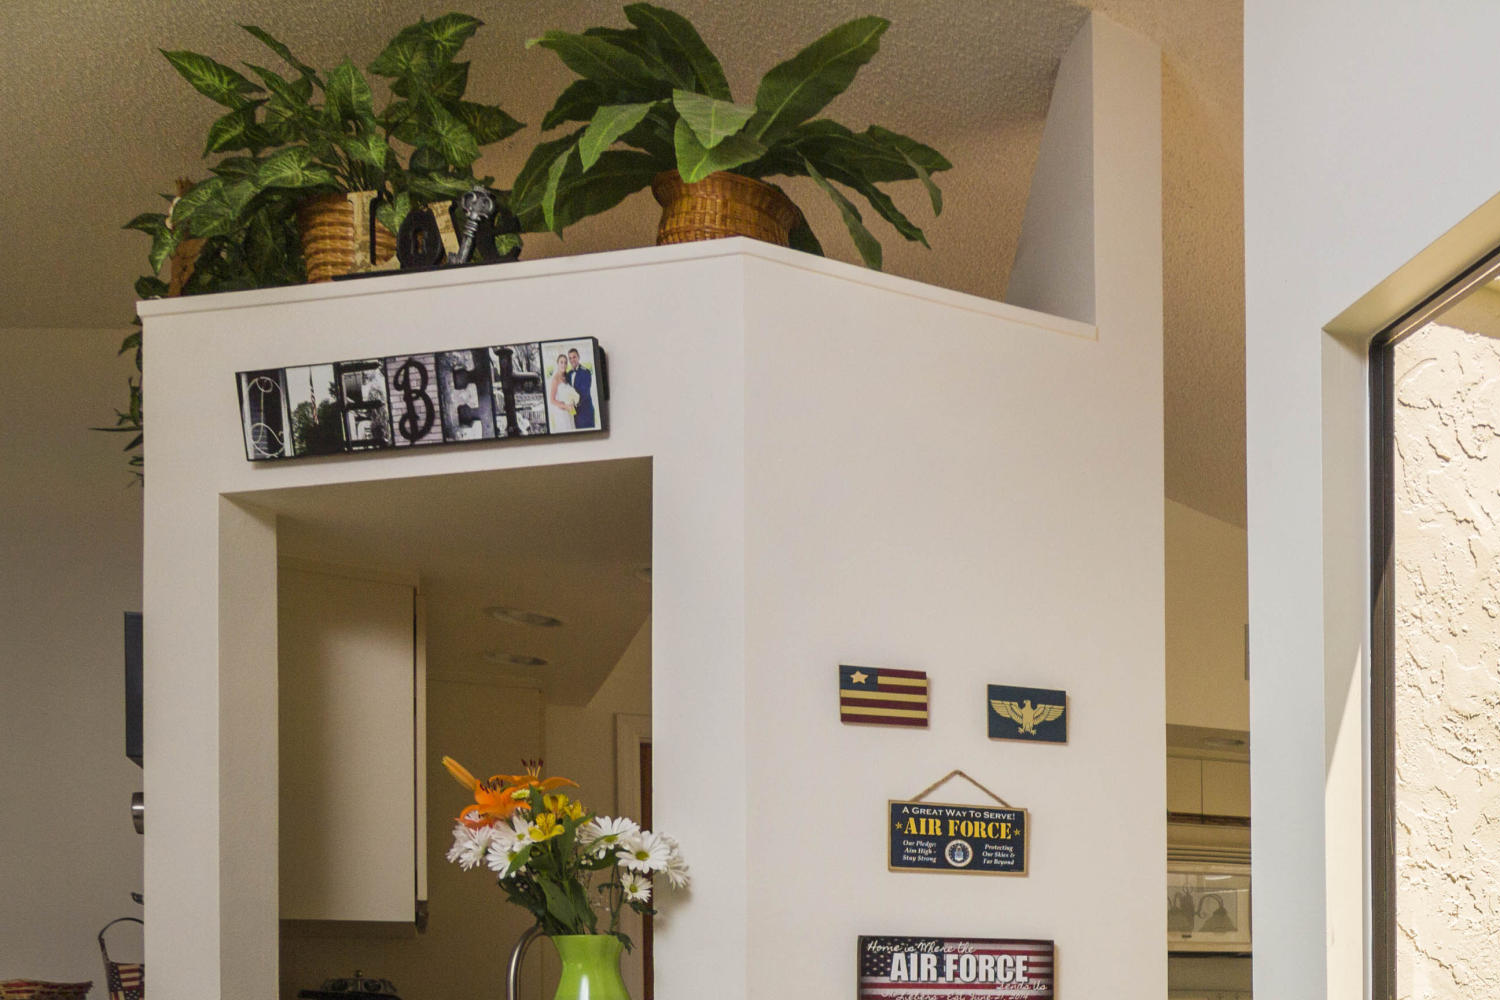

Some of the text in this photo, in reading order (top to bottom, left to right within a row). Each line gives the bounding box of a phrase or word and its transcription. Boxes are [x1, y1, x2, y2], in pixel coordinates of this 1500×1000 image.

[902, 805, 909, 814] A
[911, 807, 944, 816] GREAT
[945, 808, 967, 818] WAY
[983, 811, 1016, 820] SERVE!
[903, 817, 1012, 840] AIR FORCE
[867, 940, 901, 952] Home
[917, 940, 954, 953] Where
[957, 941, 976, 954] the
[890, 952, 1028, 983] AIR FORCE
